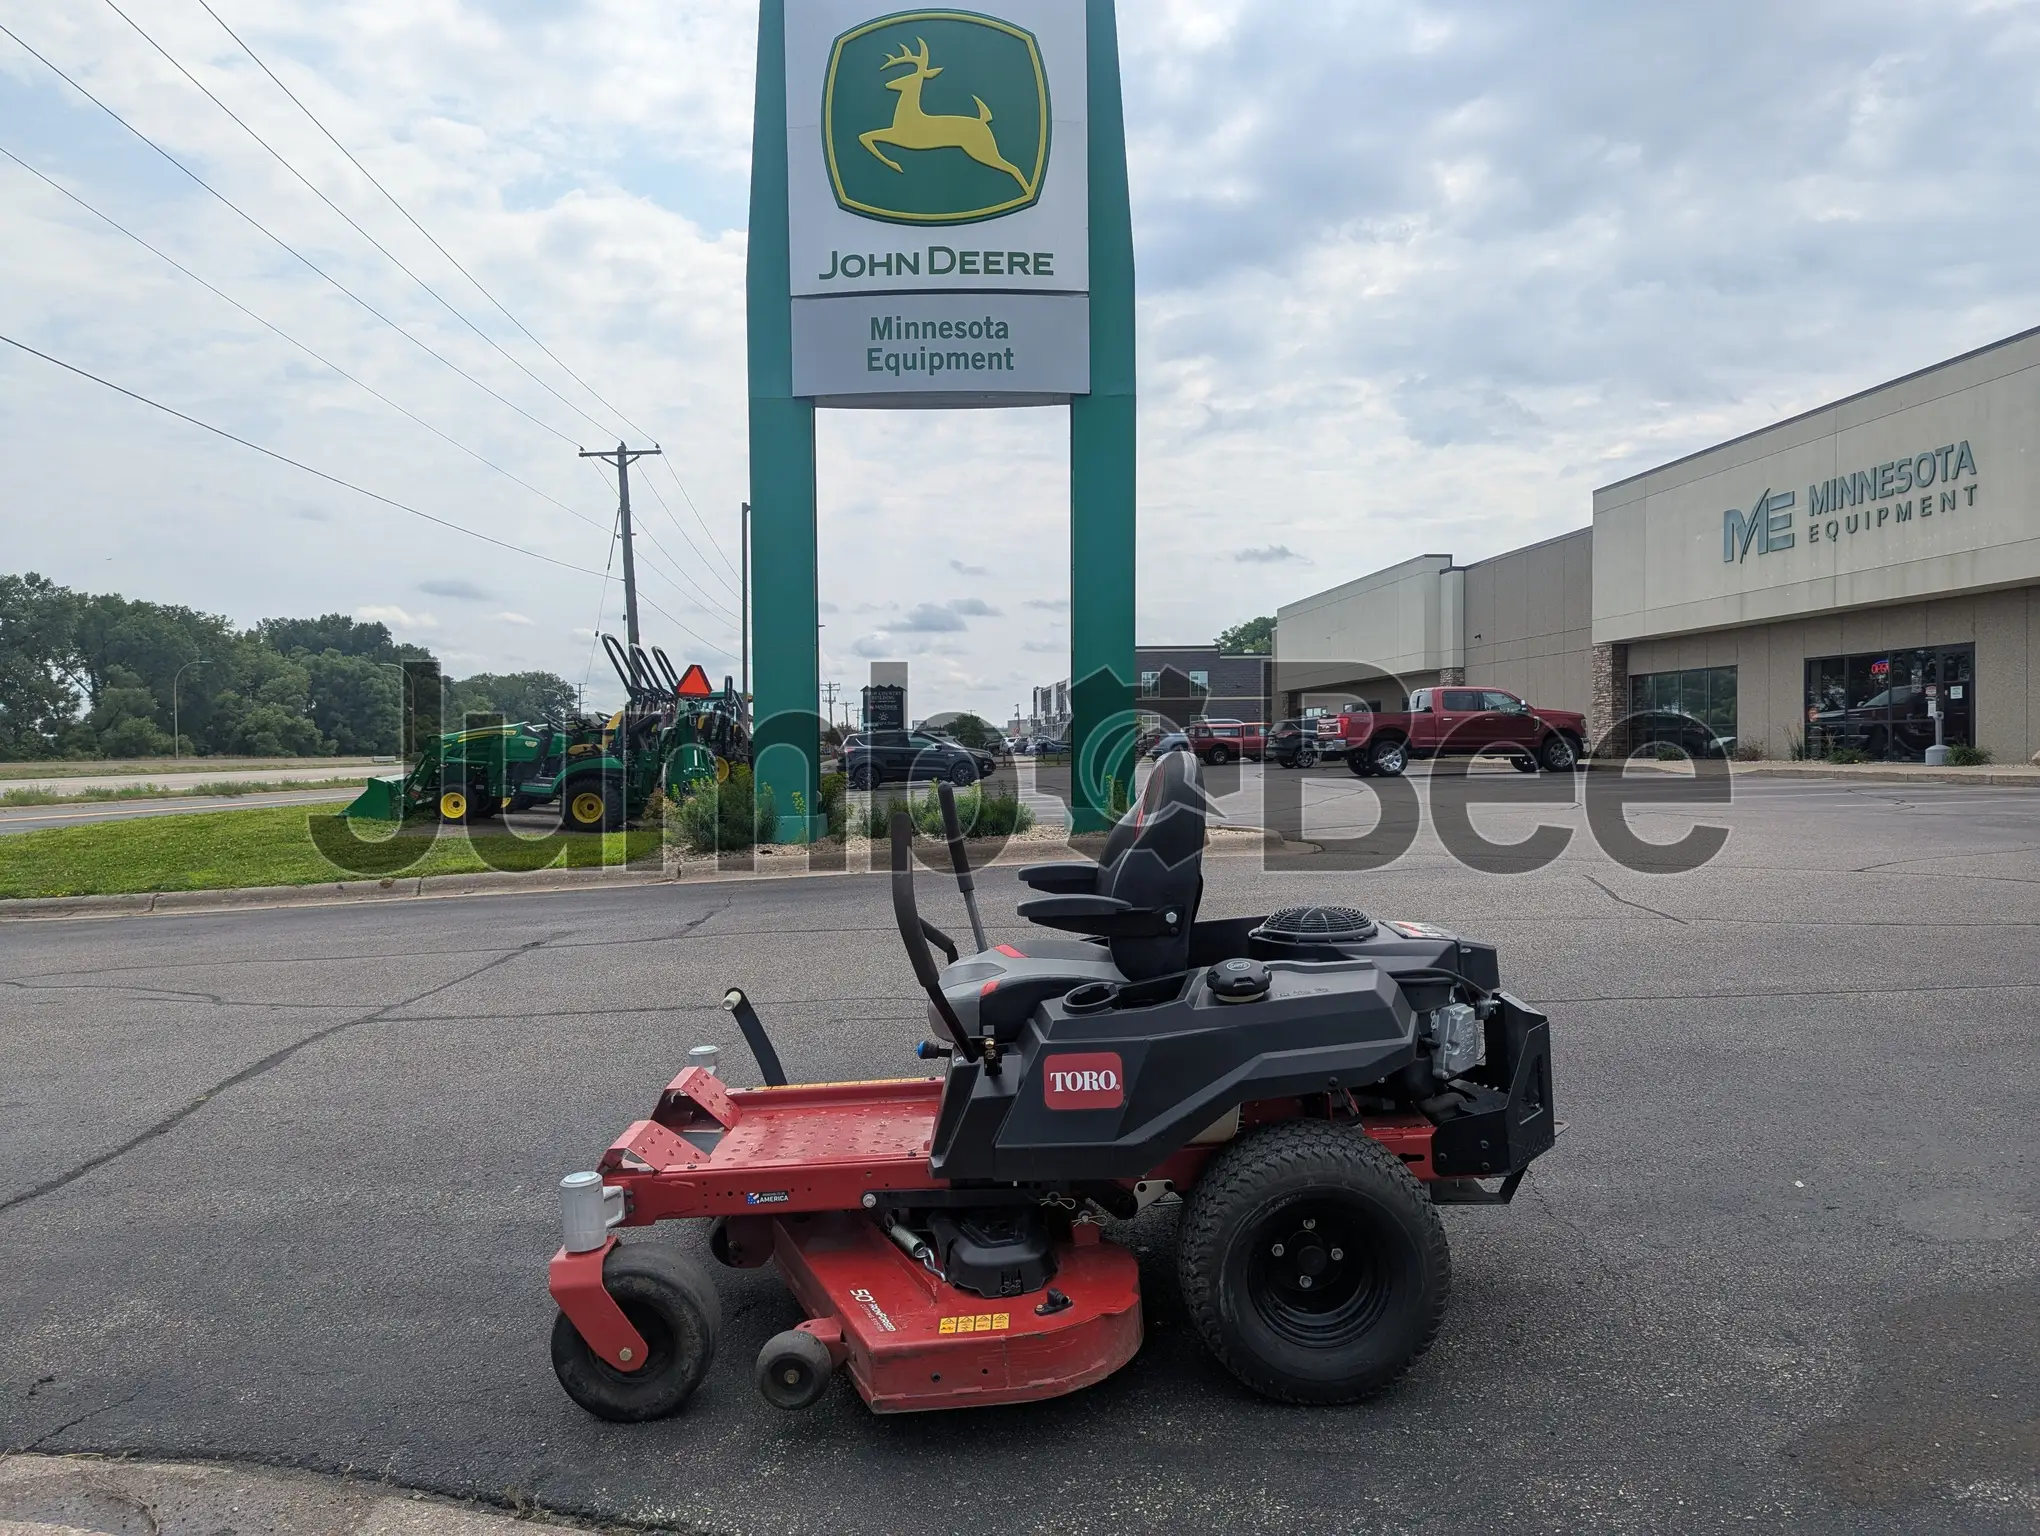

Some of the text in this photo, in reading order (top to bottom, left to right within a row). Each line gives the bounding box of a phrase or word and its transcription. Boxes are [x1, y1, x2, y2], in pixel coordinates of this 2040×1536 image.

[818, 245, 1054, 280] JOHN DEERE
[870, 315, 1009, 340] Minnesota
[866, 346, 1015, 376] Equipment
[1808, 440, 1978, 517] MINNESOTA
[1808, 484, 1978, 543] EQUIPMENT
[1050, 1069, 1119, 1092] TORO
[759, 1195, 789, 1203] AMERICA
